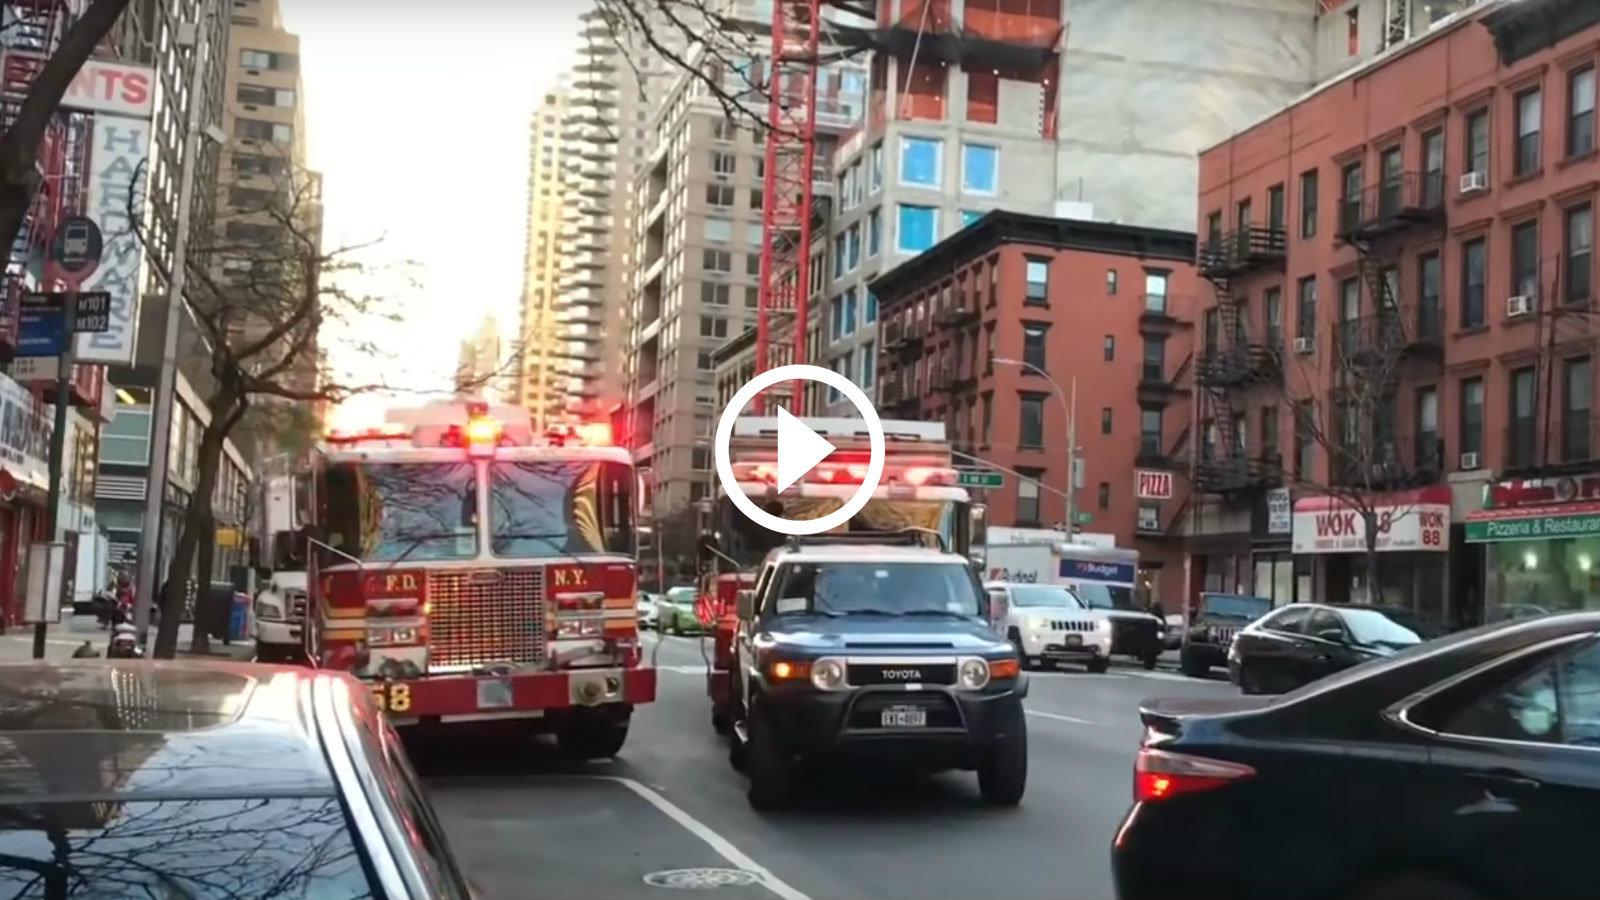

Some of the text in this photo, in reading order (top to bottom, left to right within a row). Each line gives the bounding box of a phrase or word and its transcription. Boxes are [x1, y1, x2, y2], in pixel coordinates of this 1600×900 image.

[77, 296, 107, 311] M101
[75, 315, 107, 330] M102
[1141, 473, 1170, 497] PIZZA
[1316, 512, 1356, 537] WOK
[1419, 511, 1444, 528] WOK
[1487, 522, 1530, 537] Pizzeria
[1533, 518, 1541, 534] &
[1423, 530, 1441, 545] 88
[554, 569, 588, 586] N.Y.
[1087, 563, 1119, 576] Budget
[386, 574, 418, 592] F.D.
[882, 670, 921, 679] TOYOTA
